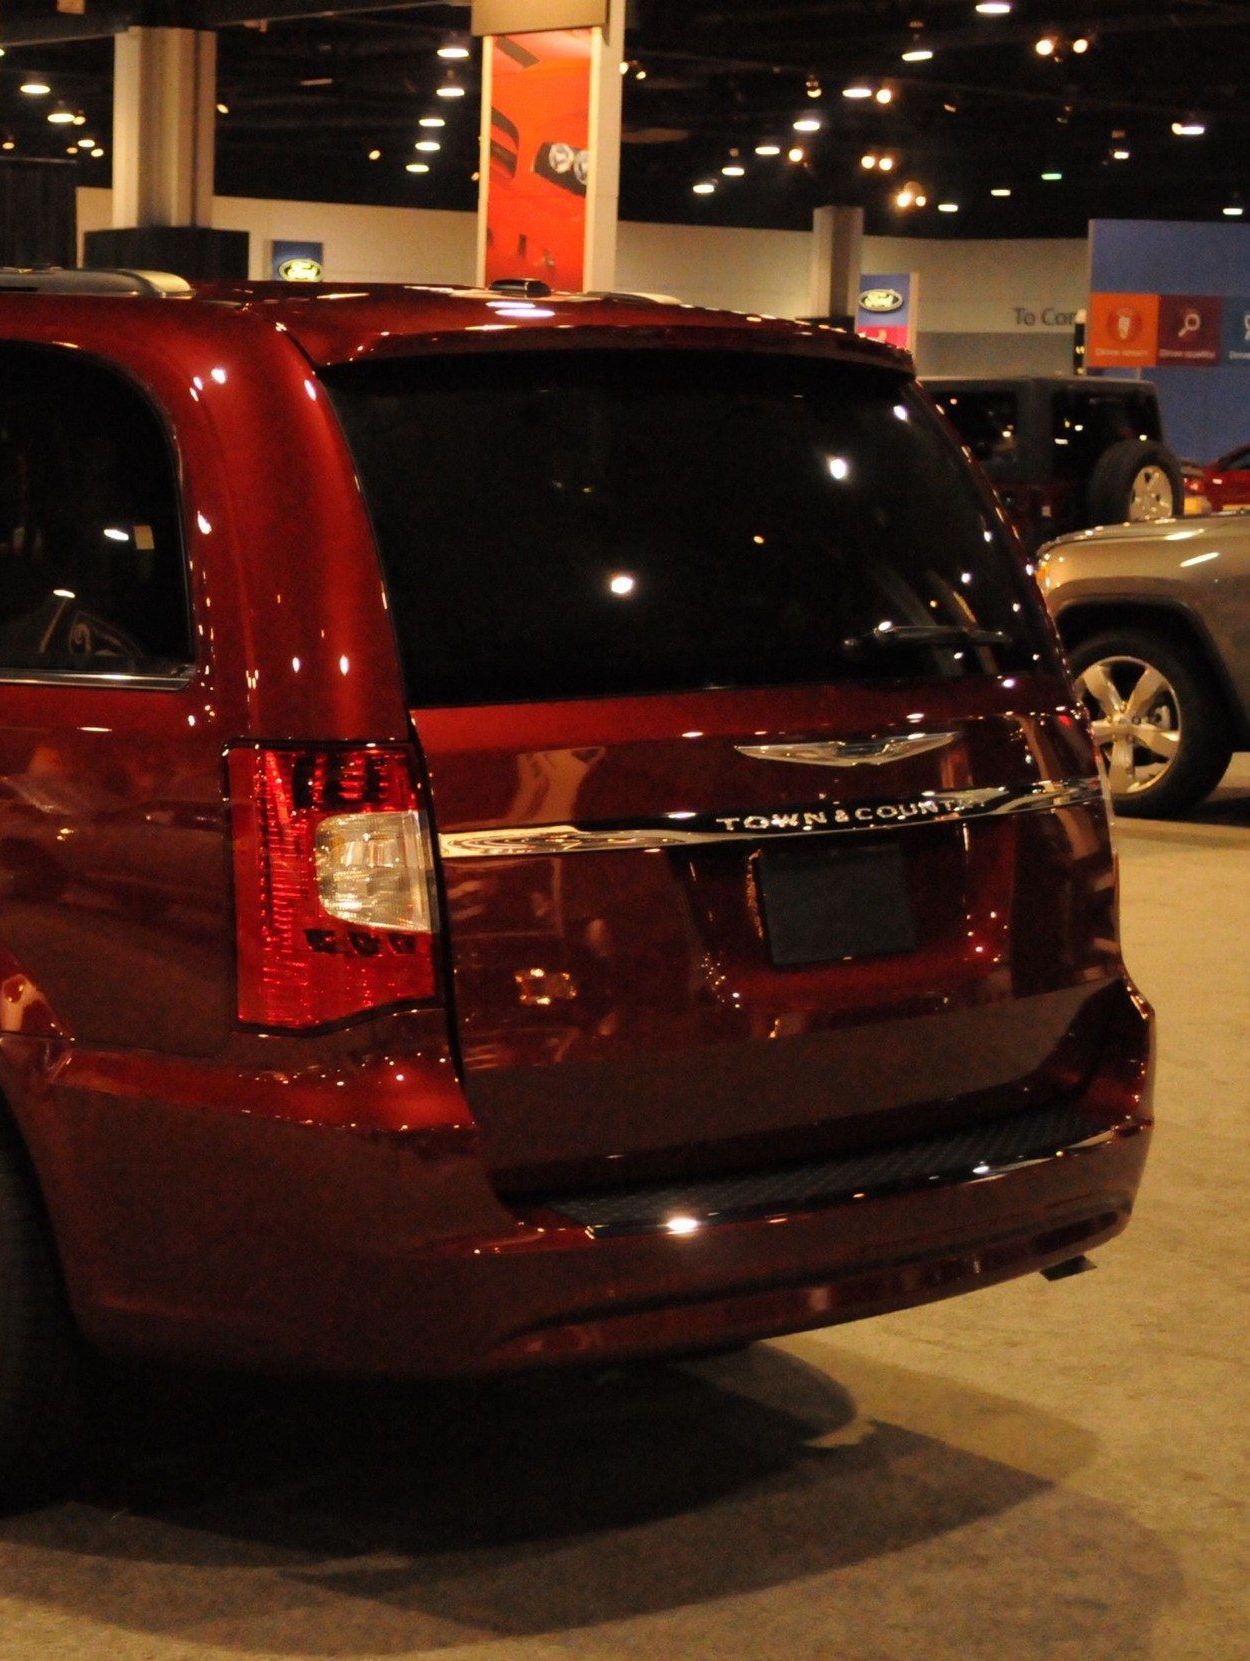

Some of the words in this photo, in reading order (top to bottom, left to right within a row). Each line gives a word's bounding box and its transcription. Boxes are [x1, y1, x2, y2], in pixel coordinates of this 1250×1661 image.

[1013, 307, 1036, 326] To
[716, 811, 827, 831] TOWN
[834, 809, 850, 823] &
[854, 798, 986, 821] COUNT
